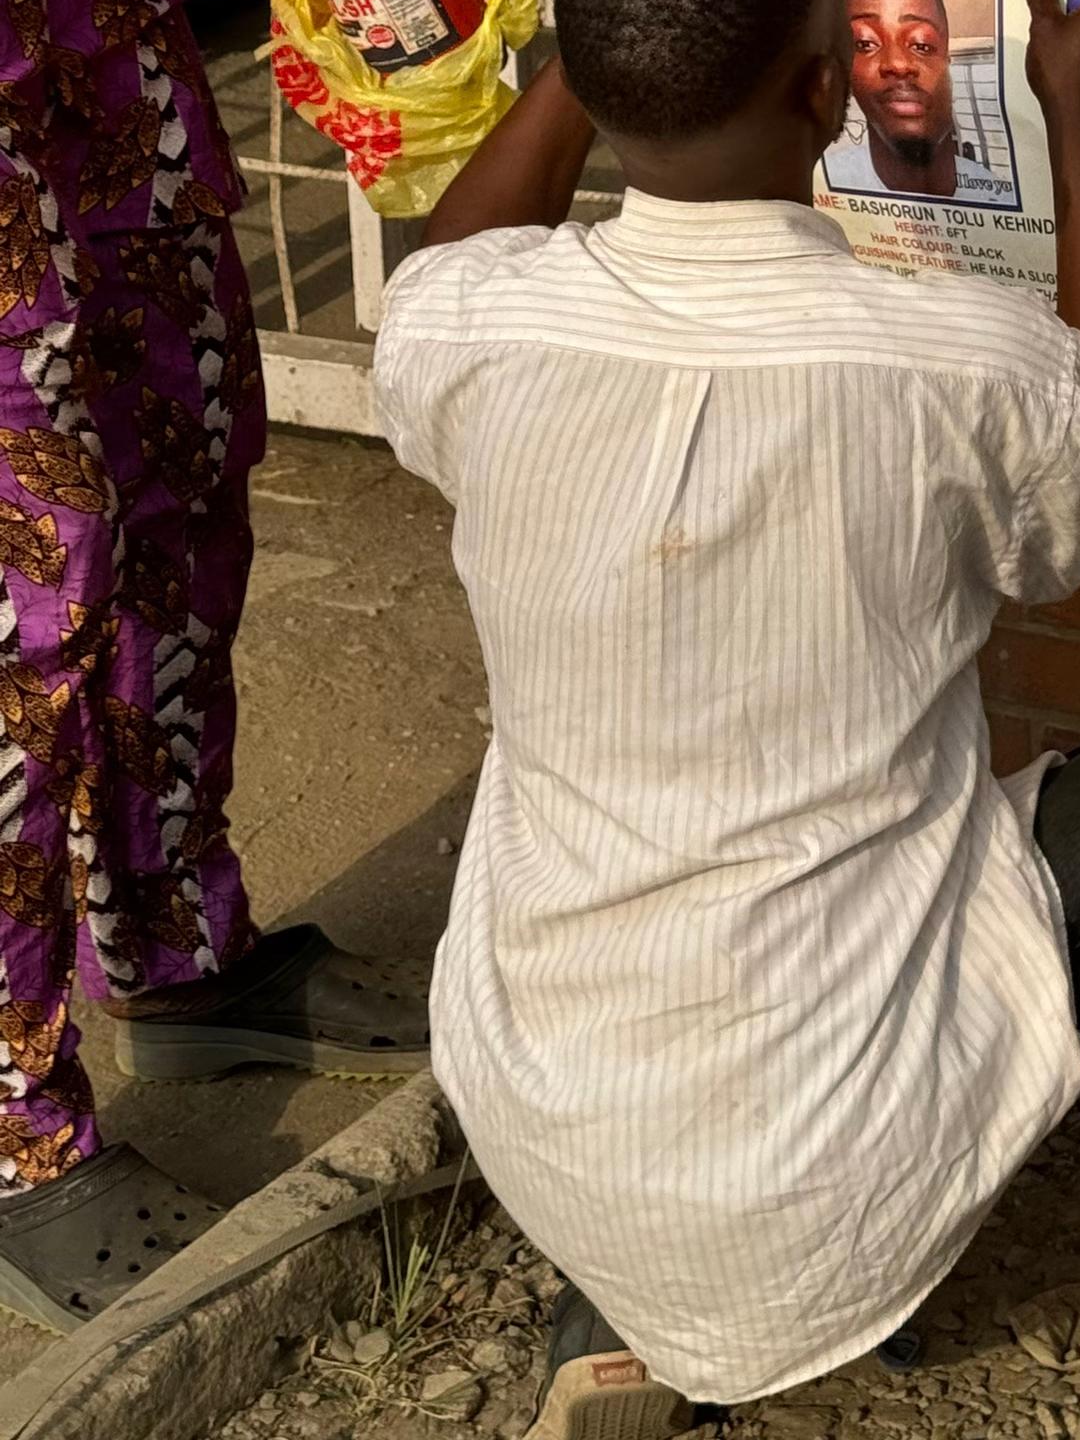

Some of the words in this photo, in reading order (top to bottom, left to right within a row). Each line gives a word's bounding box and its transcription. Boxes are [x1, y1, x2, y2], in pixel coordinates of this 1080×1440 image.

[848, 198, 935, 221] BASHORUN
[942, 208, 985, 227] TOLU
[894, 221, 944, 237] HEIGHT:
[946, 227, 968, 240] 6FT
[870, 232, 898, 247] HAIR
[901, 237, 959, 255] COLOUR:
[961, 244, 1006, 261] BLACK
[970, 262, 987, 275] HE
[989, 264, 1015, 279] HAS
[1018, 269, 1027, 281] A
